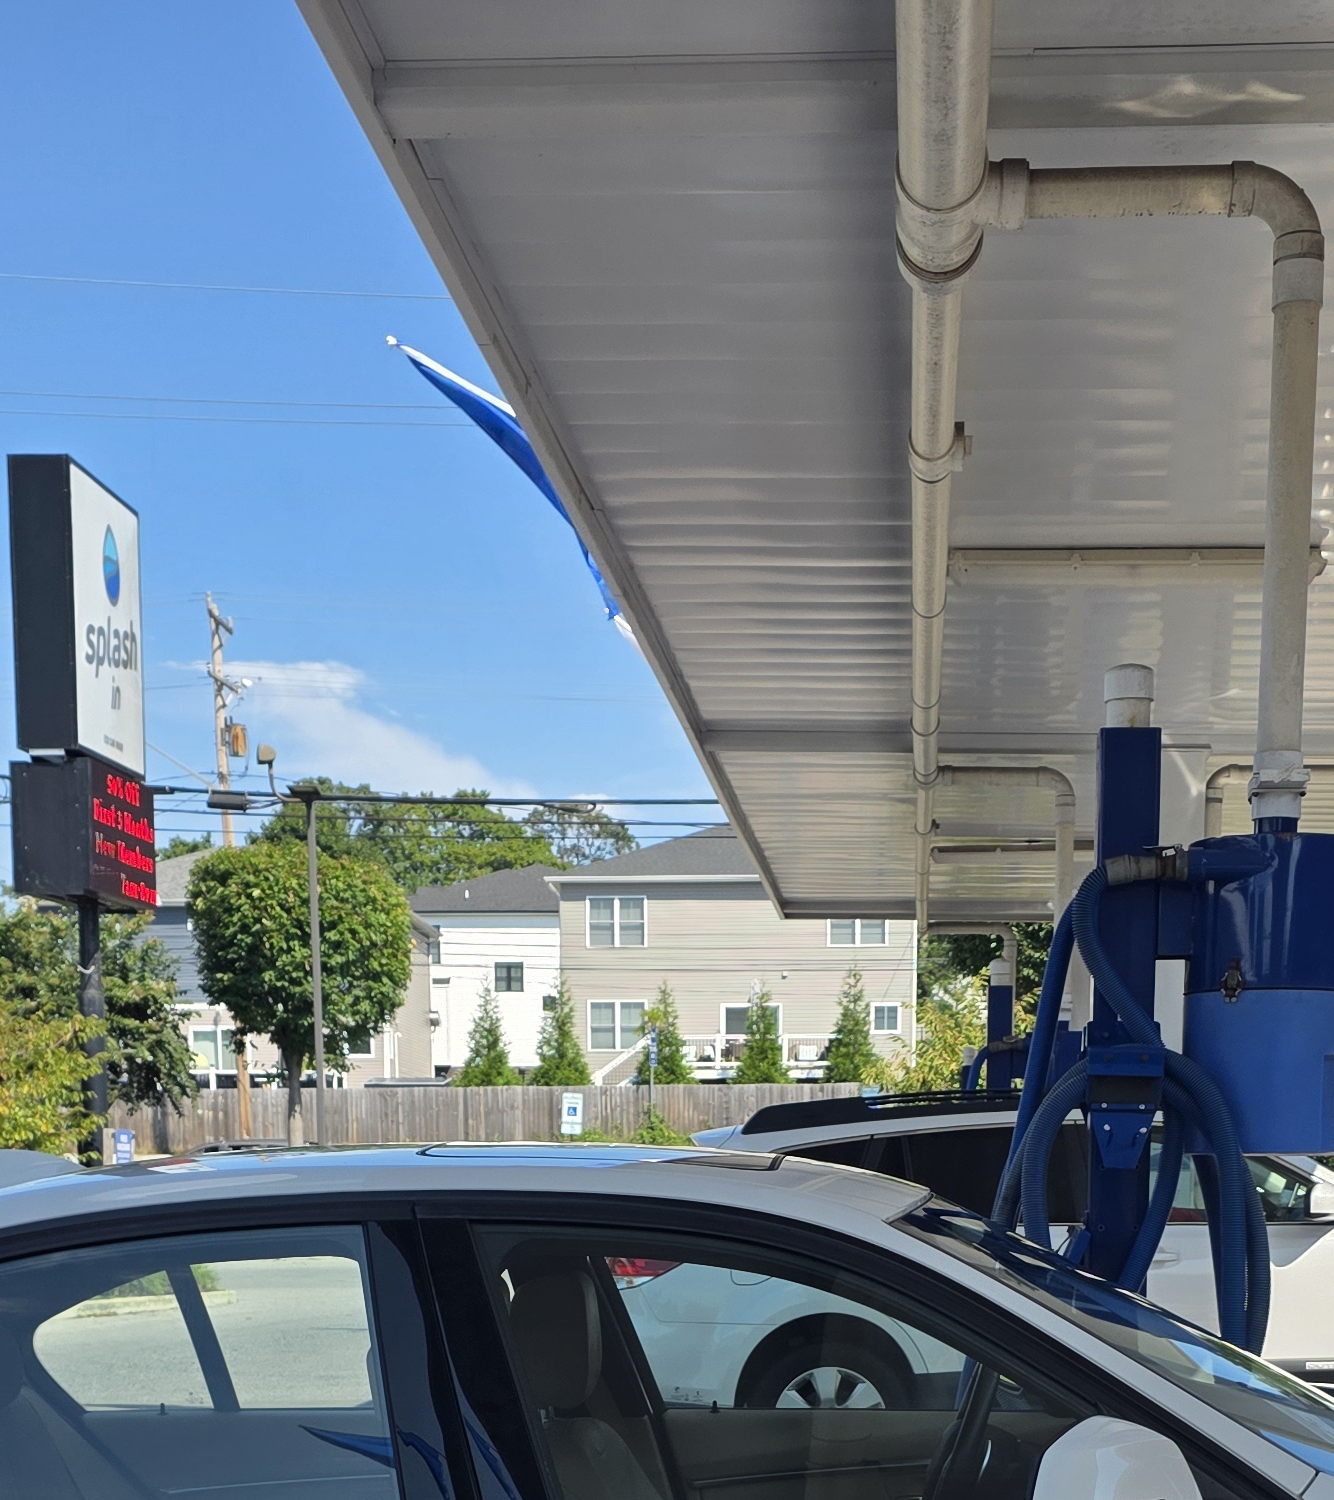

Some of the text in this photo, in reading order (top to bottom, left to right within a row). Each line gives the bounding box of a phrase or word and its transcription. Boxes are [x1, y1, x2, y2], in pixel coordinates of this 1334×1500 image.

[85, 615, 138, 678] splash
[111, 675, 121, 710] in
[107, 774, 124, 799] 50%
[93, 798, 154, 843] First 3 Months
[95, 831, 154, 874] New Members
